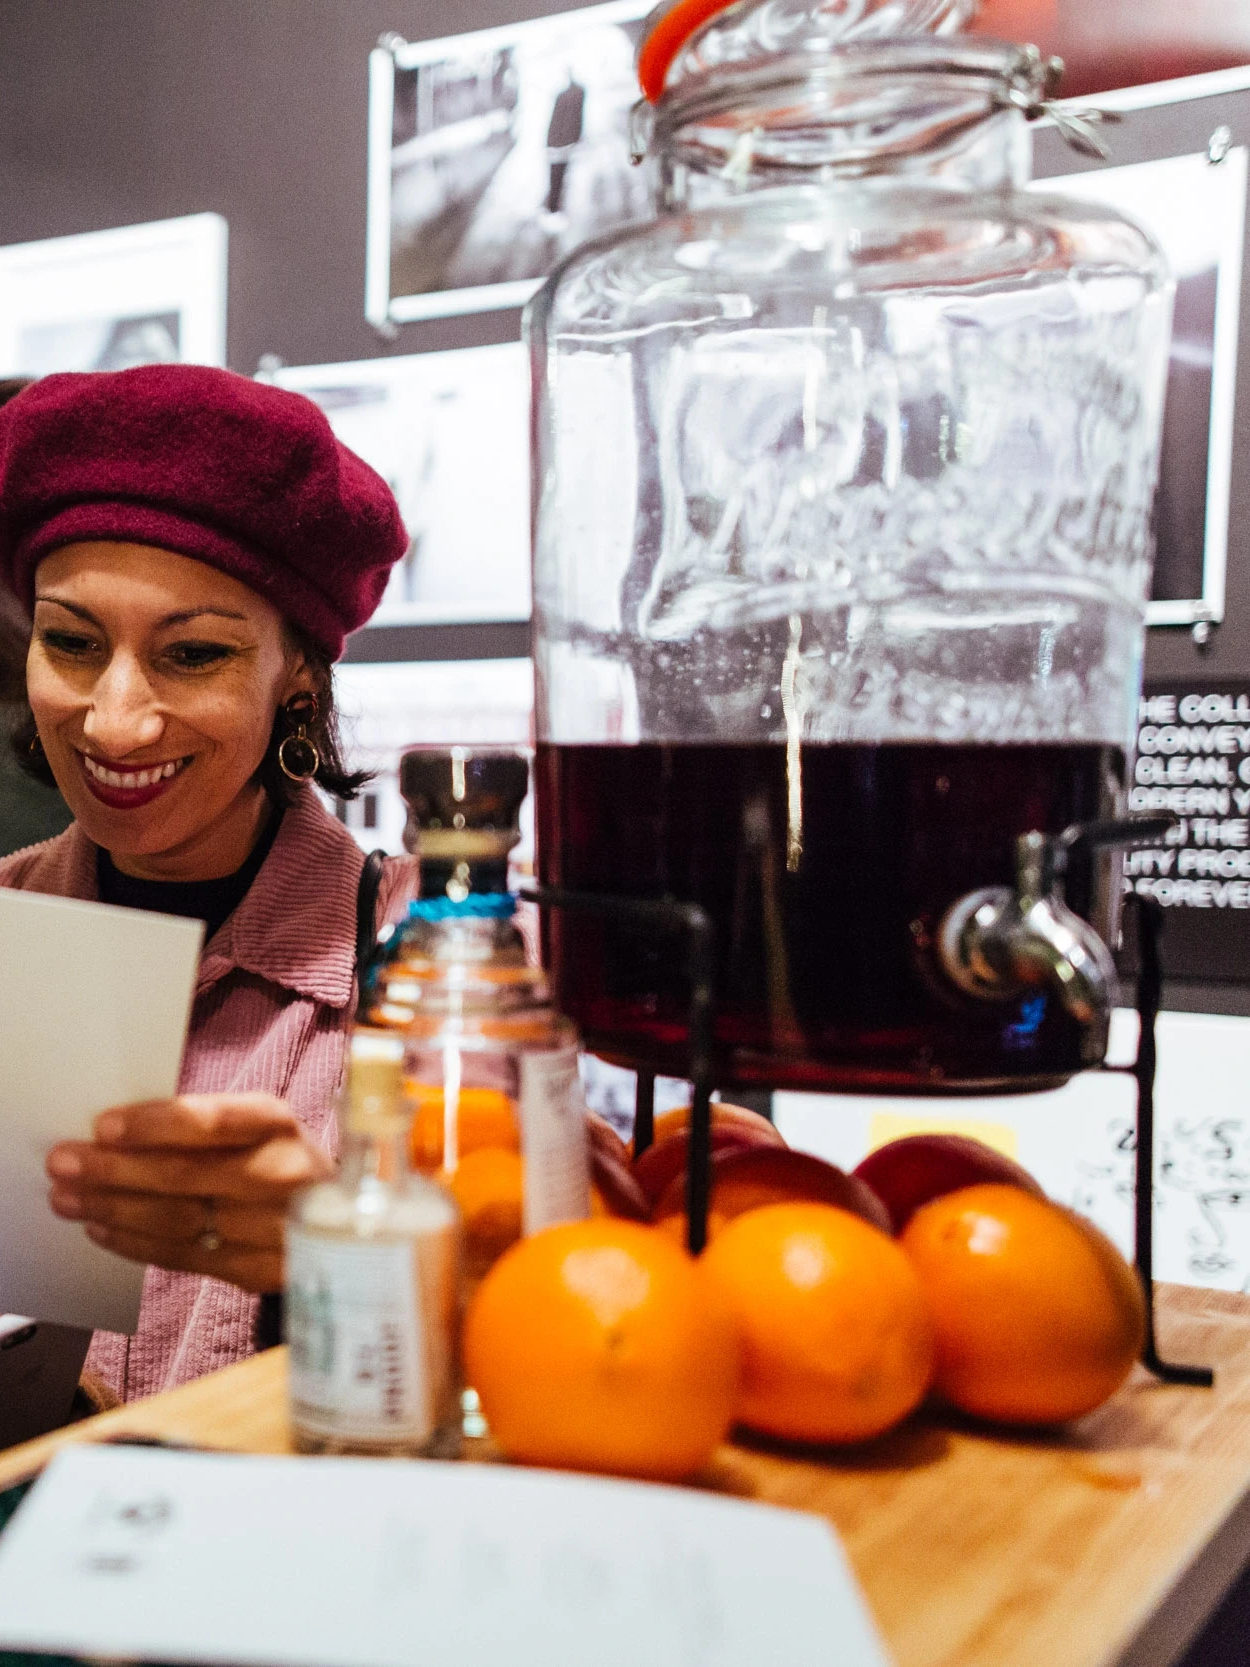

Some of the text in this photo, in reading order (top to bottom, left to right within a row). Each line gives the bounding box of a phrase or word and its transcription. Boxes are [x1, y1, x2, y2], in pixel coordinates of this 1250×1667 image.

[1139, 694, 1176, 724] HE
[1129, 786, 1231, 816] ODERN
[1190, 818, 1249, 847] THE
[1122, 848, 1176, 876] LITY
[1135, 877, 1250, 909] FOREVE
